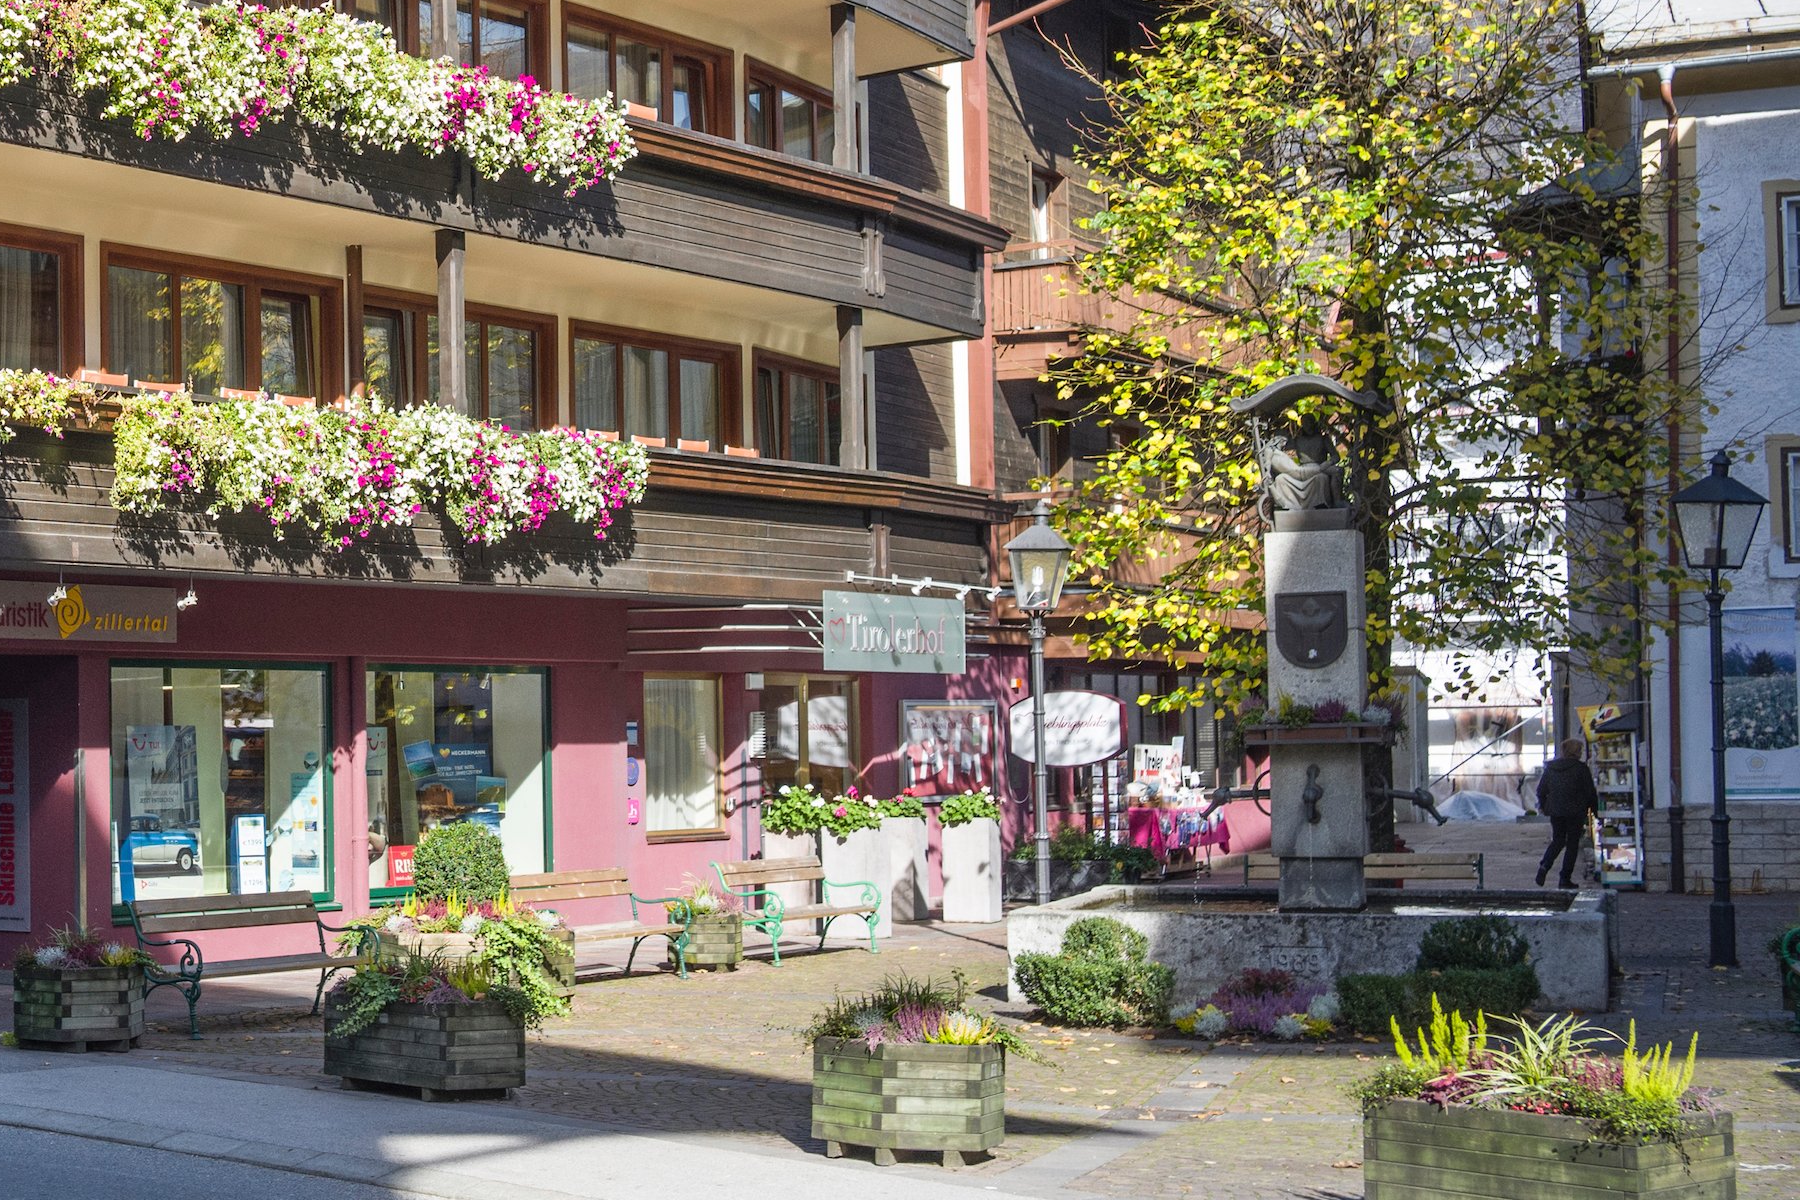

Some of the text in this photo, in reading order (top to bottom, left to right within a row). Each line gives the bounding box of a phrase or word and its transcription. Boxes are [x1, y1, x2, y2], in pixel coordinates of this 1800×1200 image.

[94, 613, 168, 632] zillertal
[846, 612, 947, 655] Tirolerhof
[1032, 713, 1112, 735] ieblingsplatz
